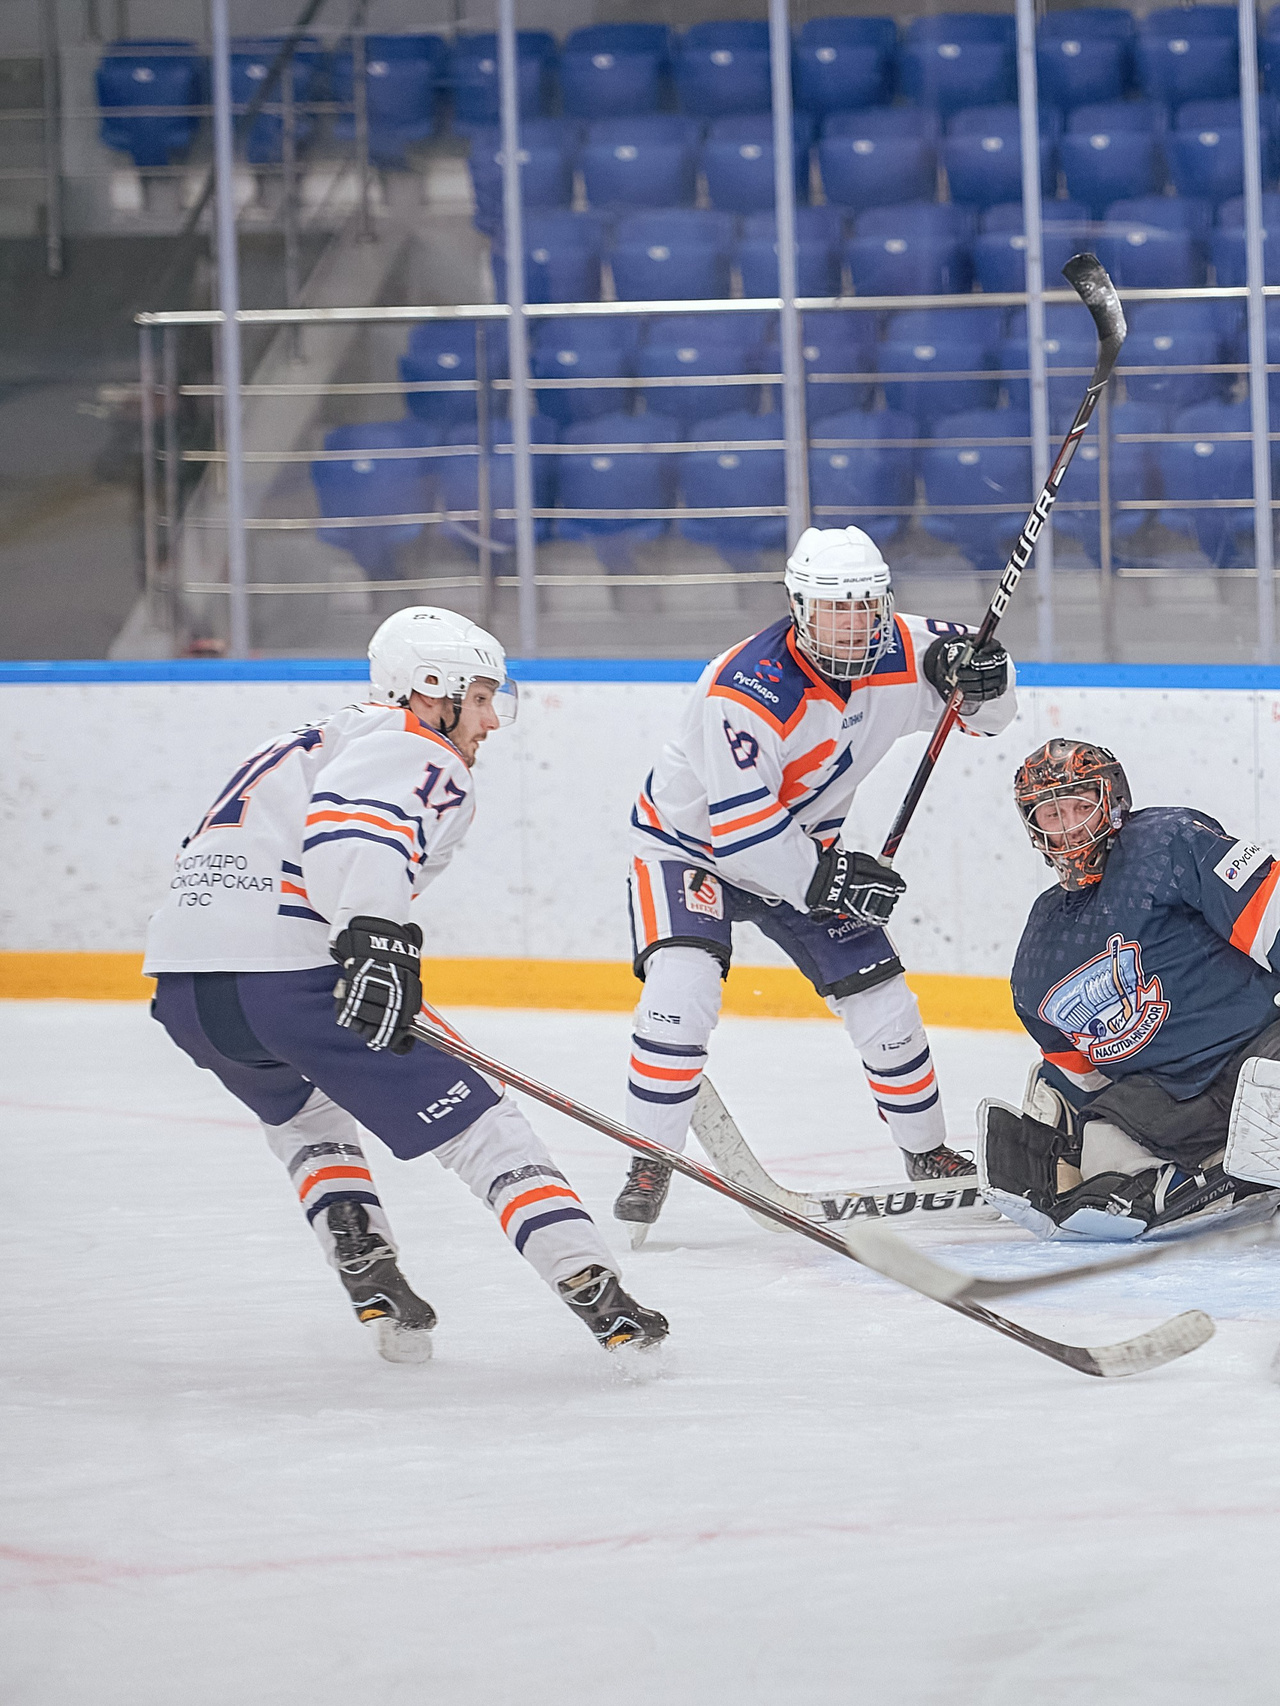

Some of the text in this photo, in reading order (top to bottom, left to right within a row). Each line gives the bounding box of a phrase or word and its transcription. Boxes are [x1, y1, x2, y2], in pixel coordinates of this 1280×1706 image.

[990, 488, 1056, 618] BAUER
[733, 670, 780, 704] РусГидро
[414, 761, 467, 820] 17
[175, 854, 248, 871] УСГИДРО
[1231, 844, 1262, 871] РусГи
[170, 873, 274, 892] ОКСАРСКАЯ
[178, 892, 213, 907] ГЭС
[827, 919, 867, 939] РусГид
[820, 1187, 990, 1221] VAUGH
